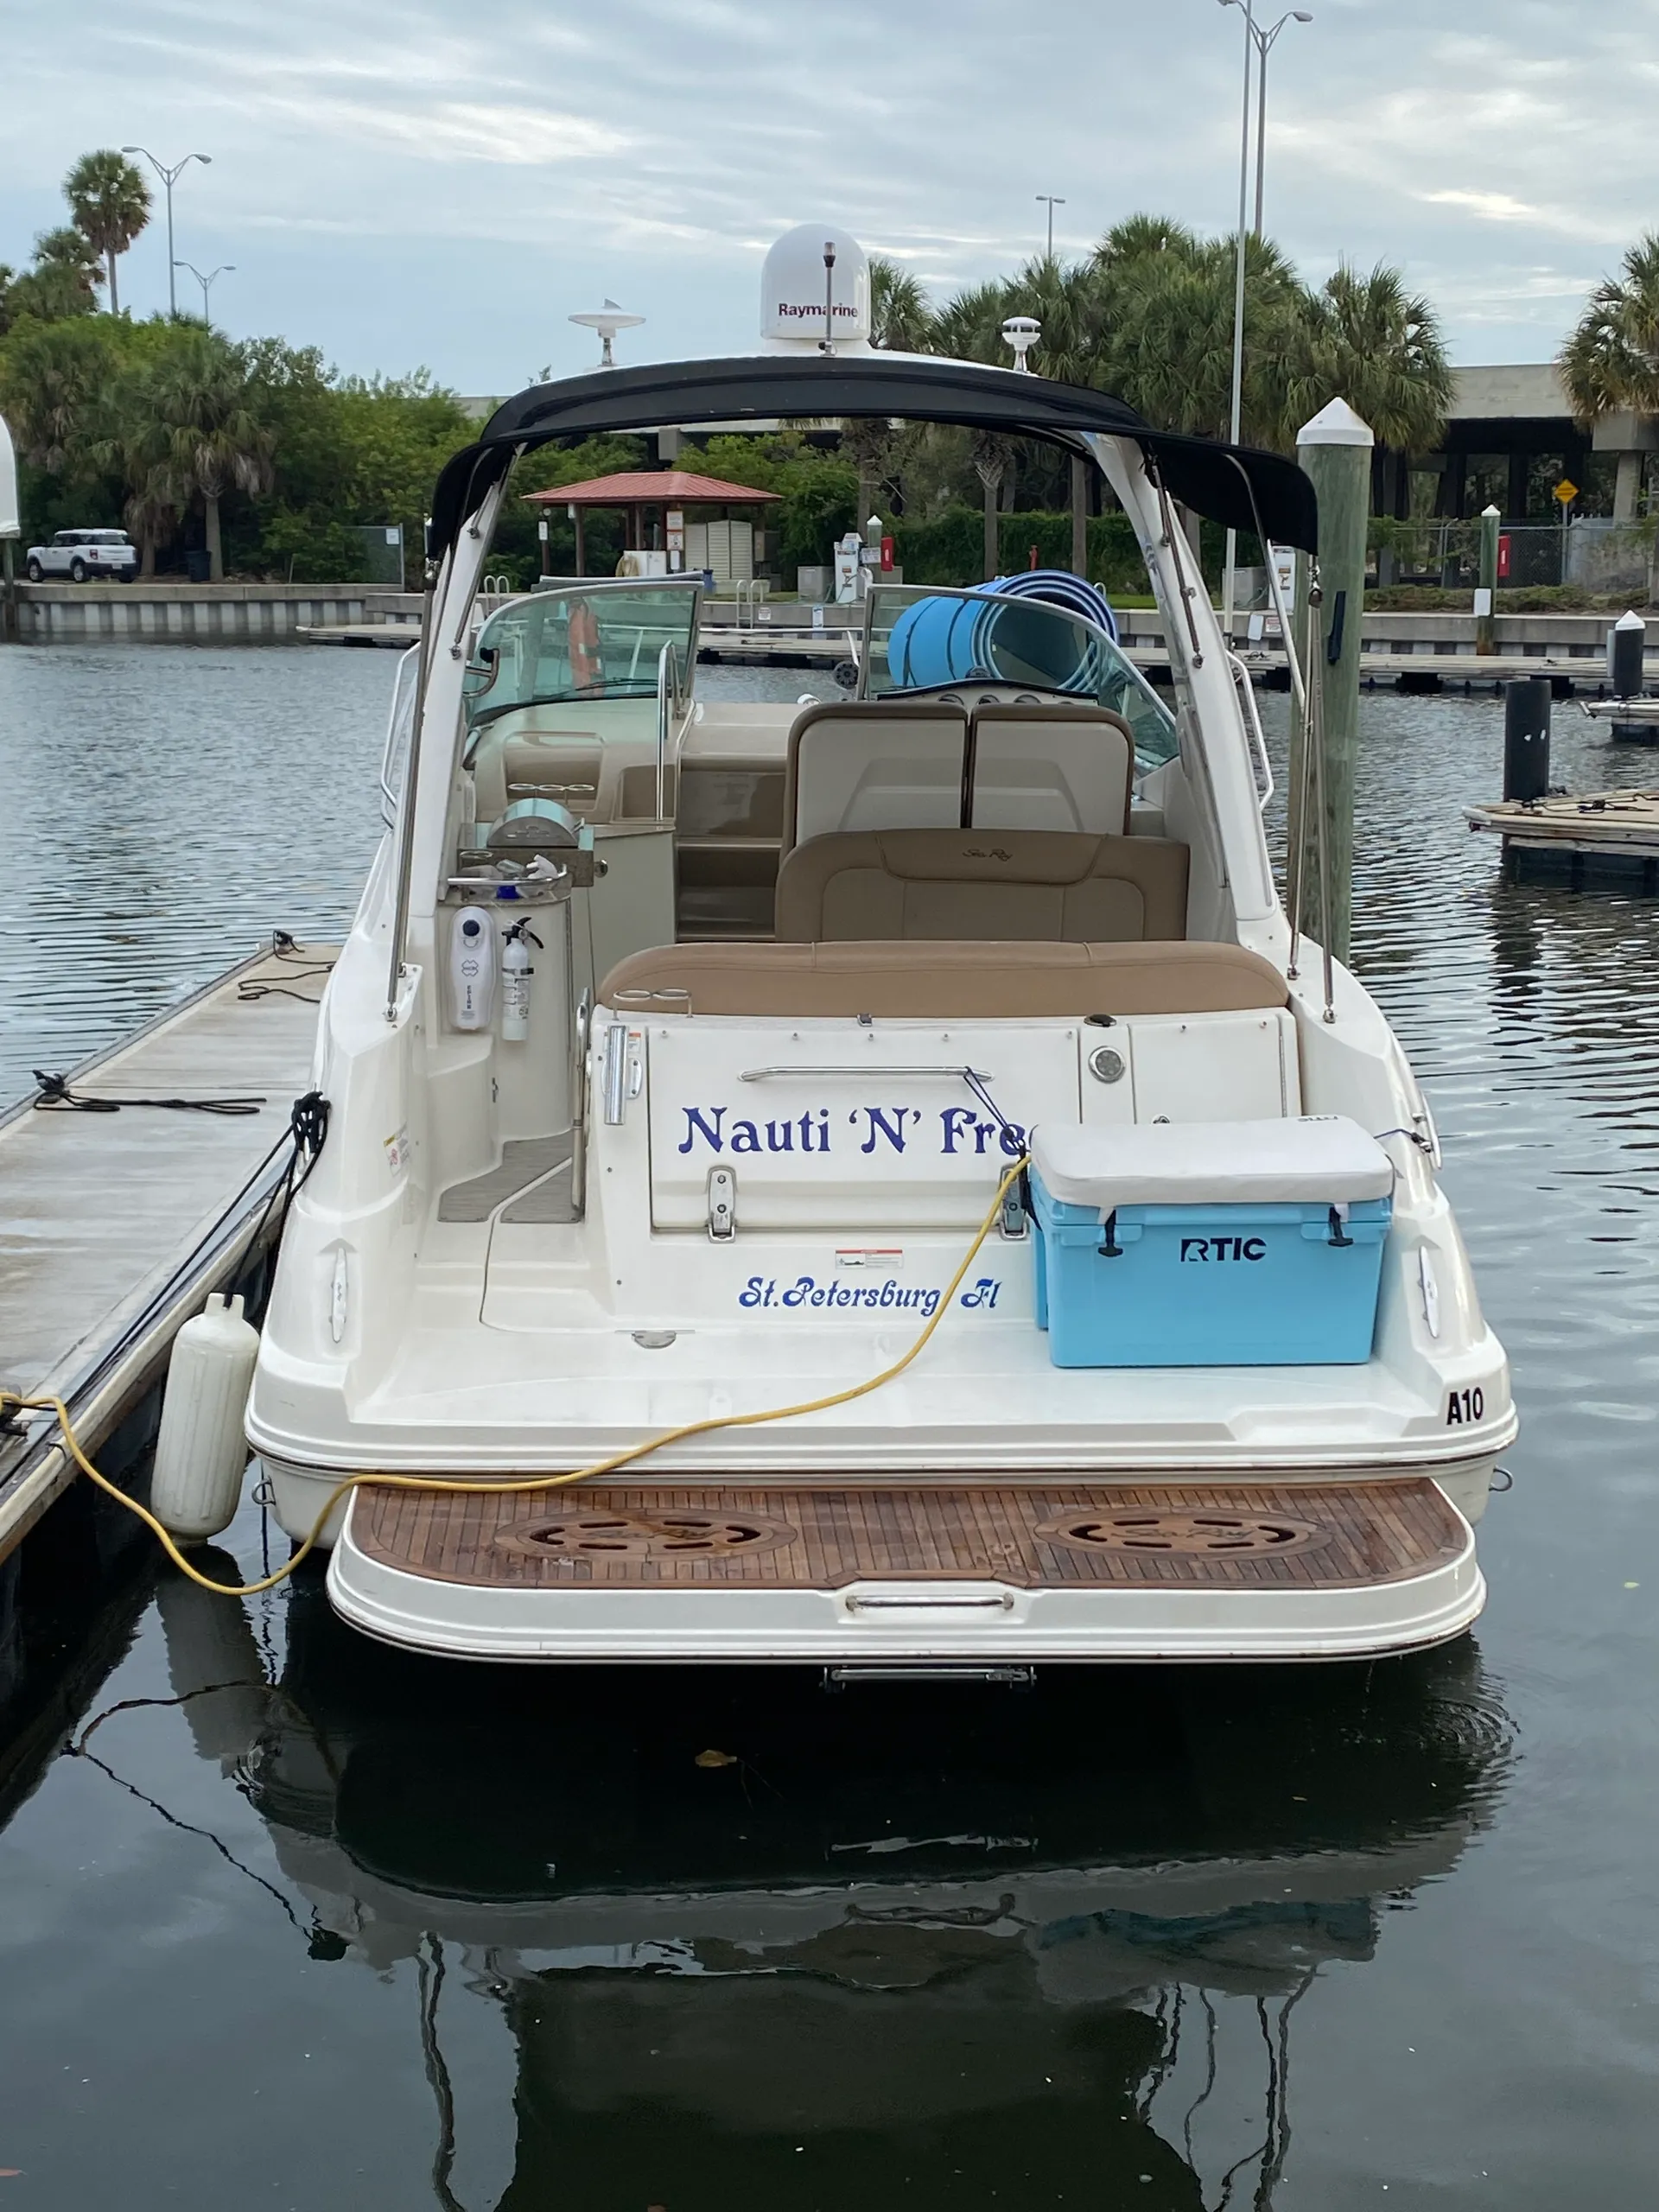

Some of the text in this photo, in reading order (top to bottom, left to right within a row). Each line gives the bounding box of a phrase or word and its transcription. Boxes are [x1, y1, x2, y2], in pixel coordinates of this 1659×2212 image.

[677, 1107, 830, 1154] Nauti
[1180, 1237, 1267, 1262] RTIC
[960, 1278, 1002, 1309] Fl
[1446, 1387, 1484, 1426] A10
